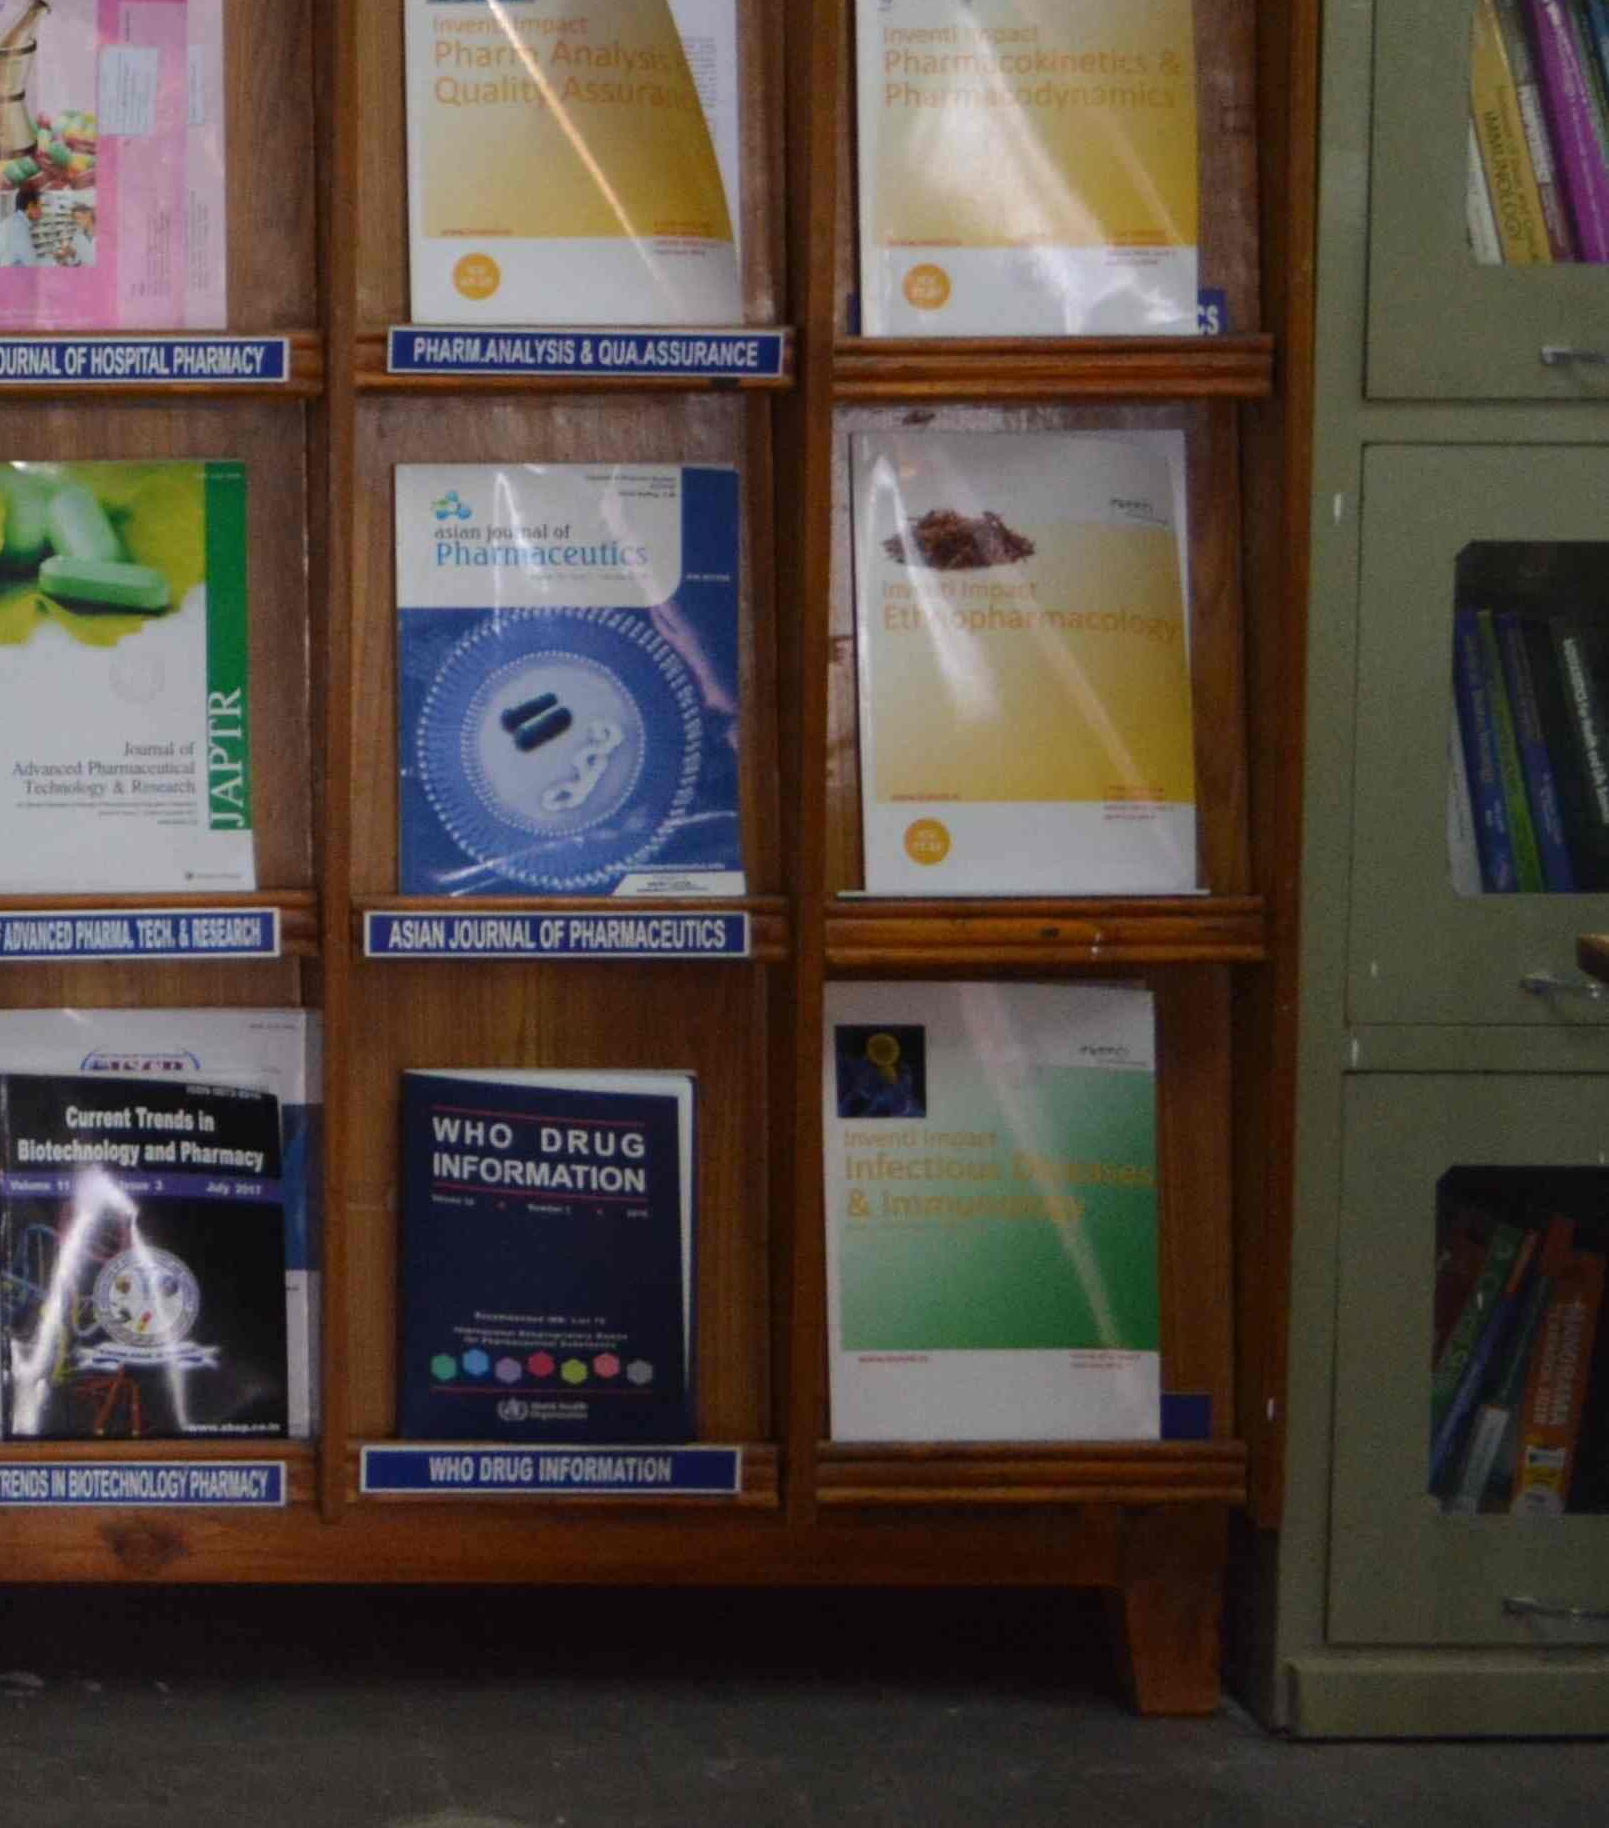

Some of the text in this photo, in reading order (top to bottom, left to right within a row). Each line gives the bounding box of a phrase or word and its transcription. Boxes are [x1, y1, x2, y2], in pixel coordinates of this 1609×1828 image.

[65, 346, 88, 375] OF
[91, 345, 169, 375] HOSPITAL
[173, 345, 265, 375] PHARMACY
[207, 687, 246, 828] JAPTR
[389, 919, 726, 949] ASIAN JOURNAL OF PHARMACEUTICS
[65, 1105, 215, 1133] Current Trends in
[431, 1115, 646, 1158] WHO DRUG
[17, 1139, 264, 1173] Biotechnology and Pharmacy
[432, 1151, 646, 1194] INFORMATION
[429, 1456, 672, 1483] WHO DRUG INFORMATION
